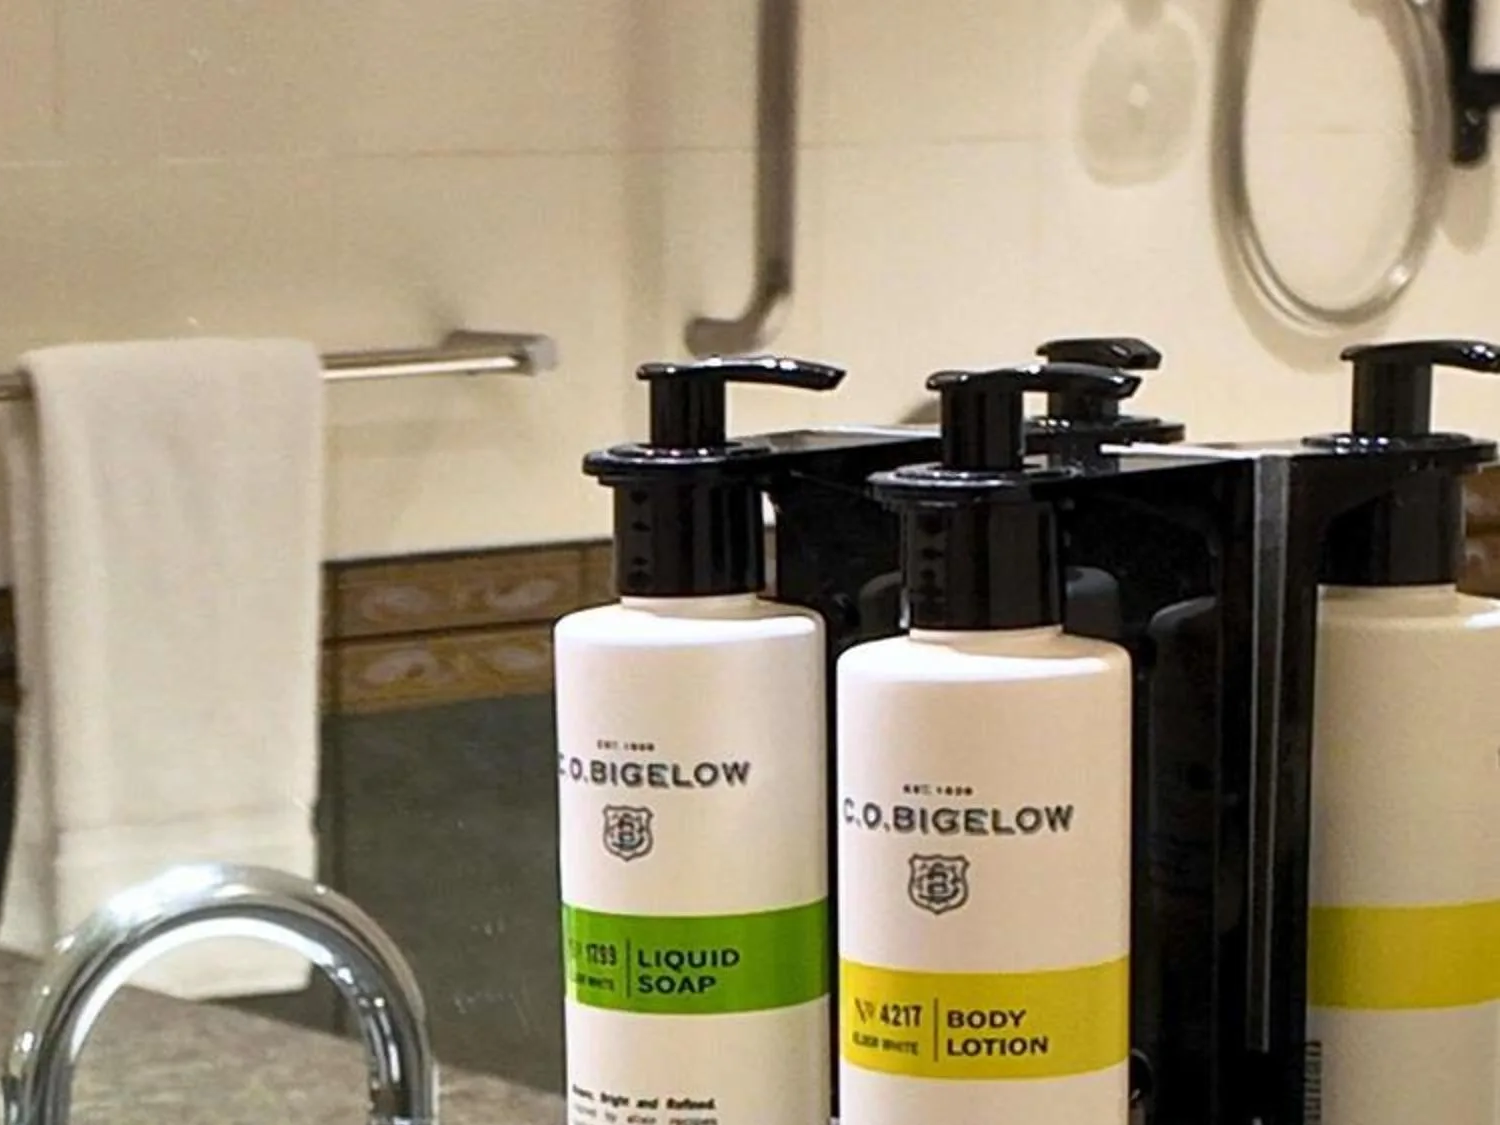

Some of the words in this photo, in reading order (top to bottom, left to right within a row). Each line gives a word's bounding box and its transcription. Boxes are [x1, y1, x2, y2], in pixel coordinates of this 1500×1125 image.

[637, 948, 740, 971] LIQUID
[638, 975, 717, 994] SOAP
[880, 1003, 922, 1027] 4217
[947, 1010, 1027, 1030] BODY
[947, 1036, 1049, 1057] LOTION
